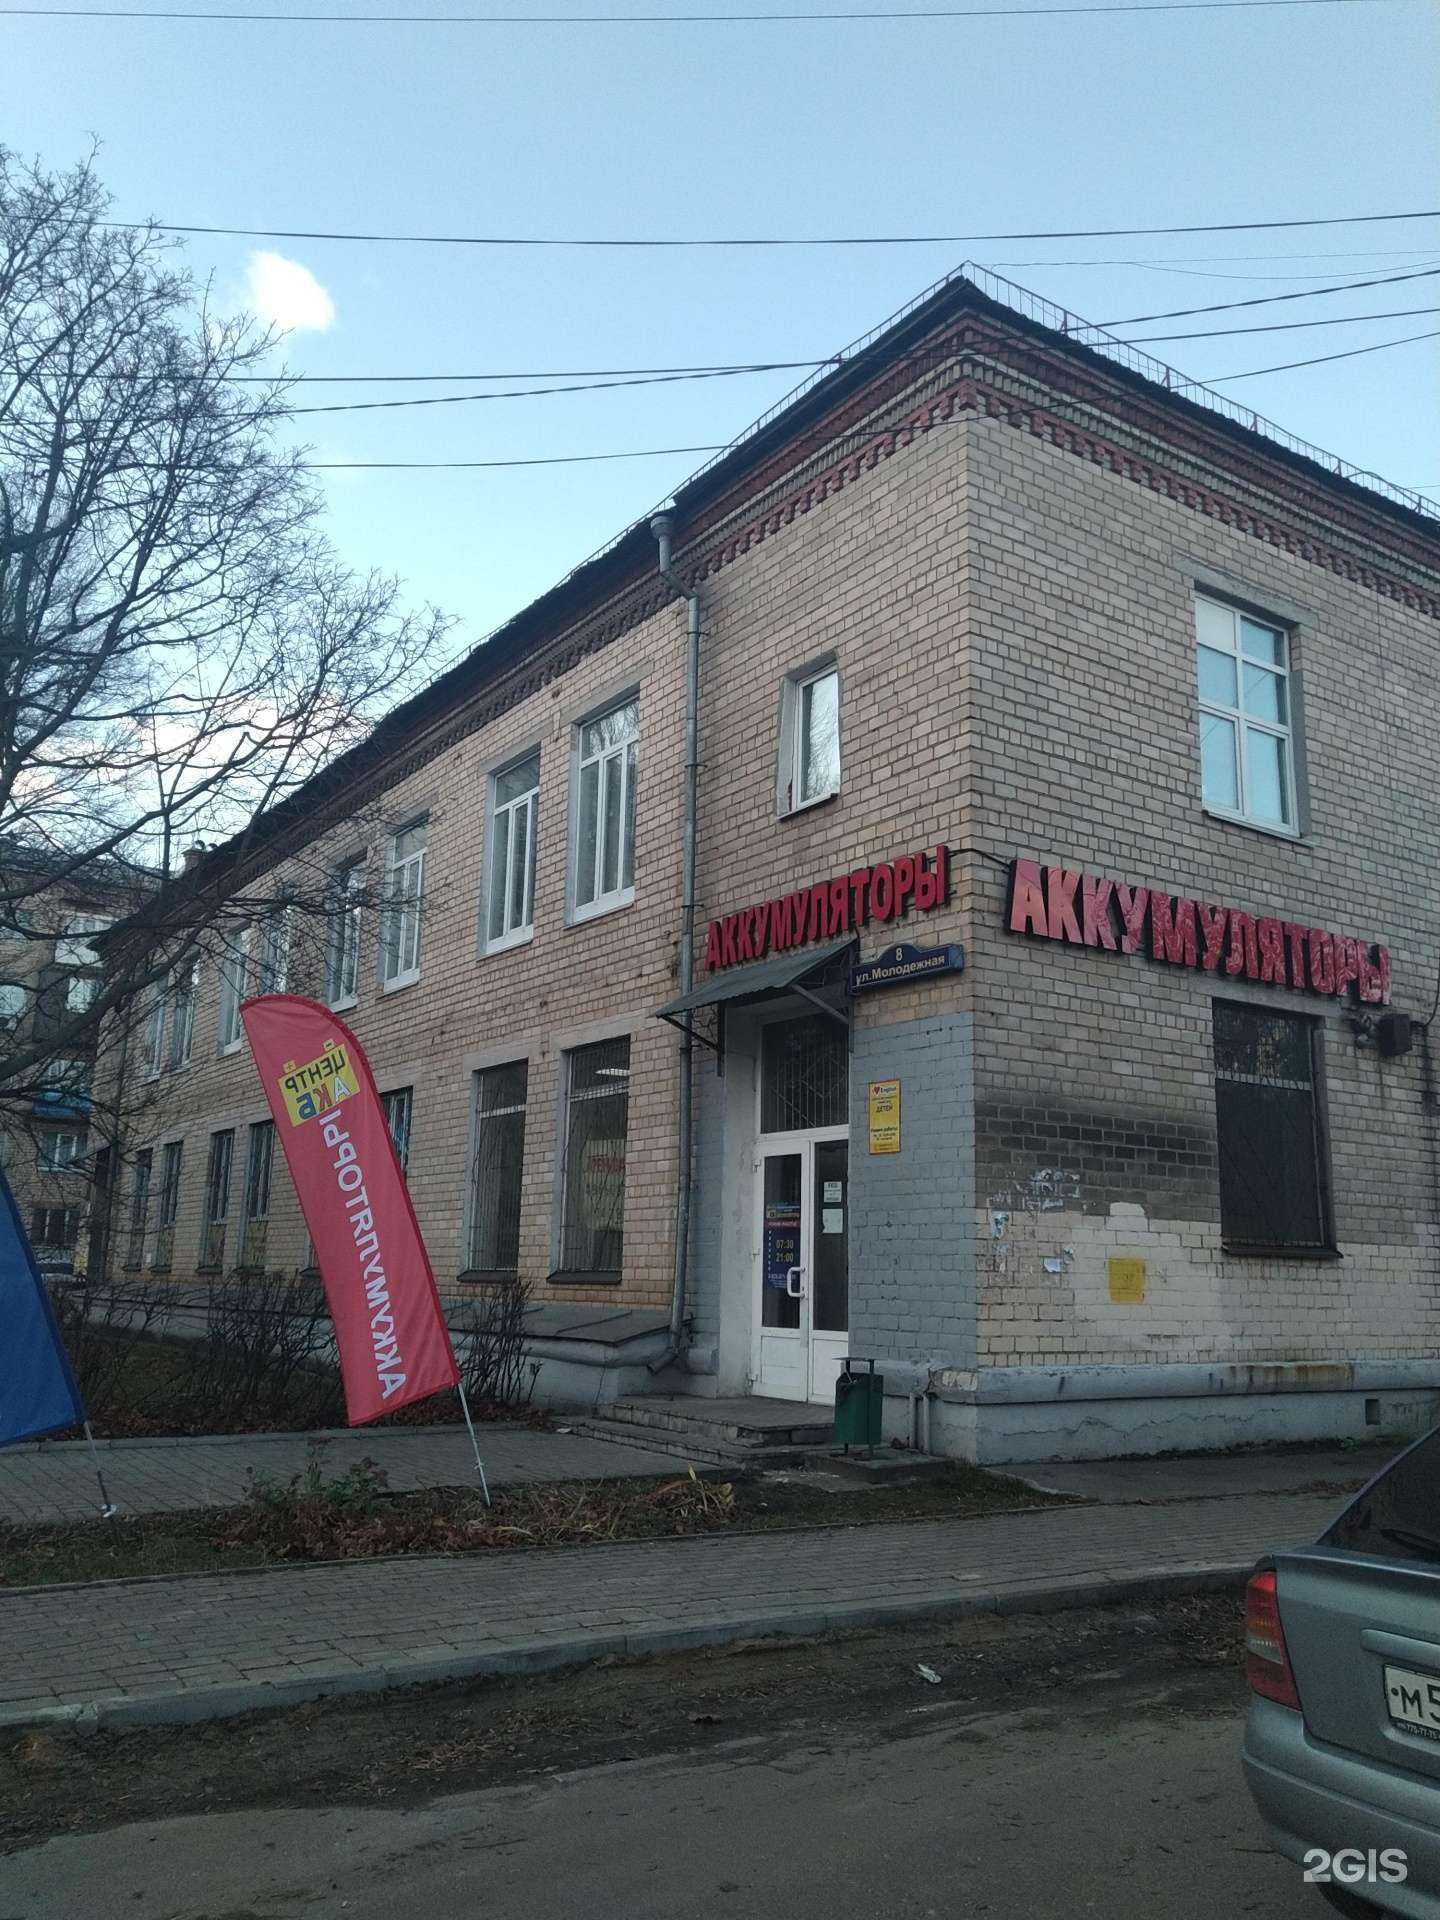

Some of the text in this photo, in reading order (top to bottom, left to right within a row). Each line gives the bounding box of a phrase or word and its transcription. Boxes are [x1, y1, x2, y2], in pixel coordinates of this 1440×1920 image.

[704, 845, 948, 970] АККУМУЛЯТОРЫ
[895, 947, 904, 962] 8
[1009, 859, 1392, 1005] АККУМУЛЯТОРЫ
